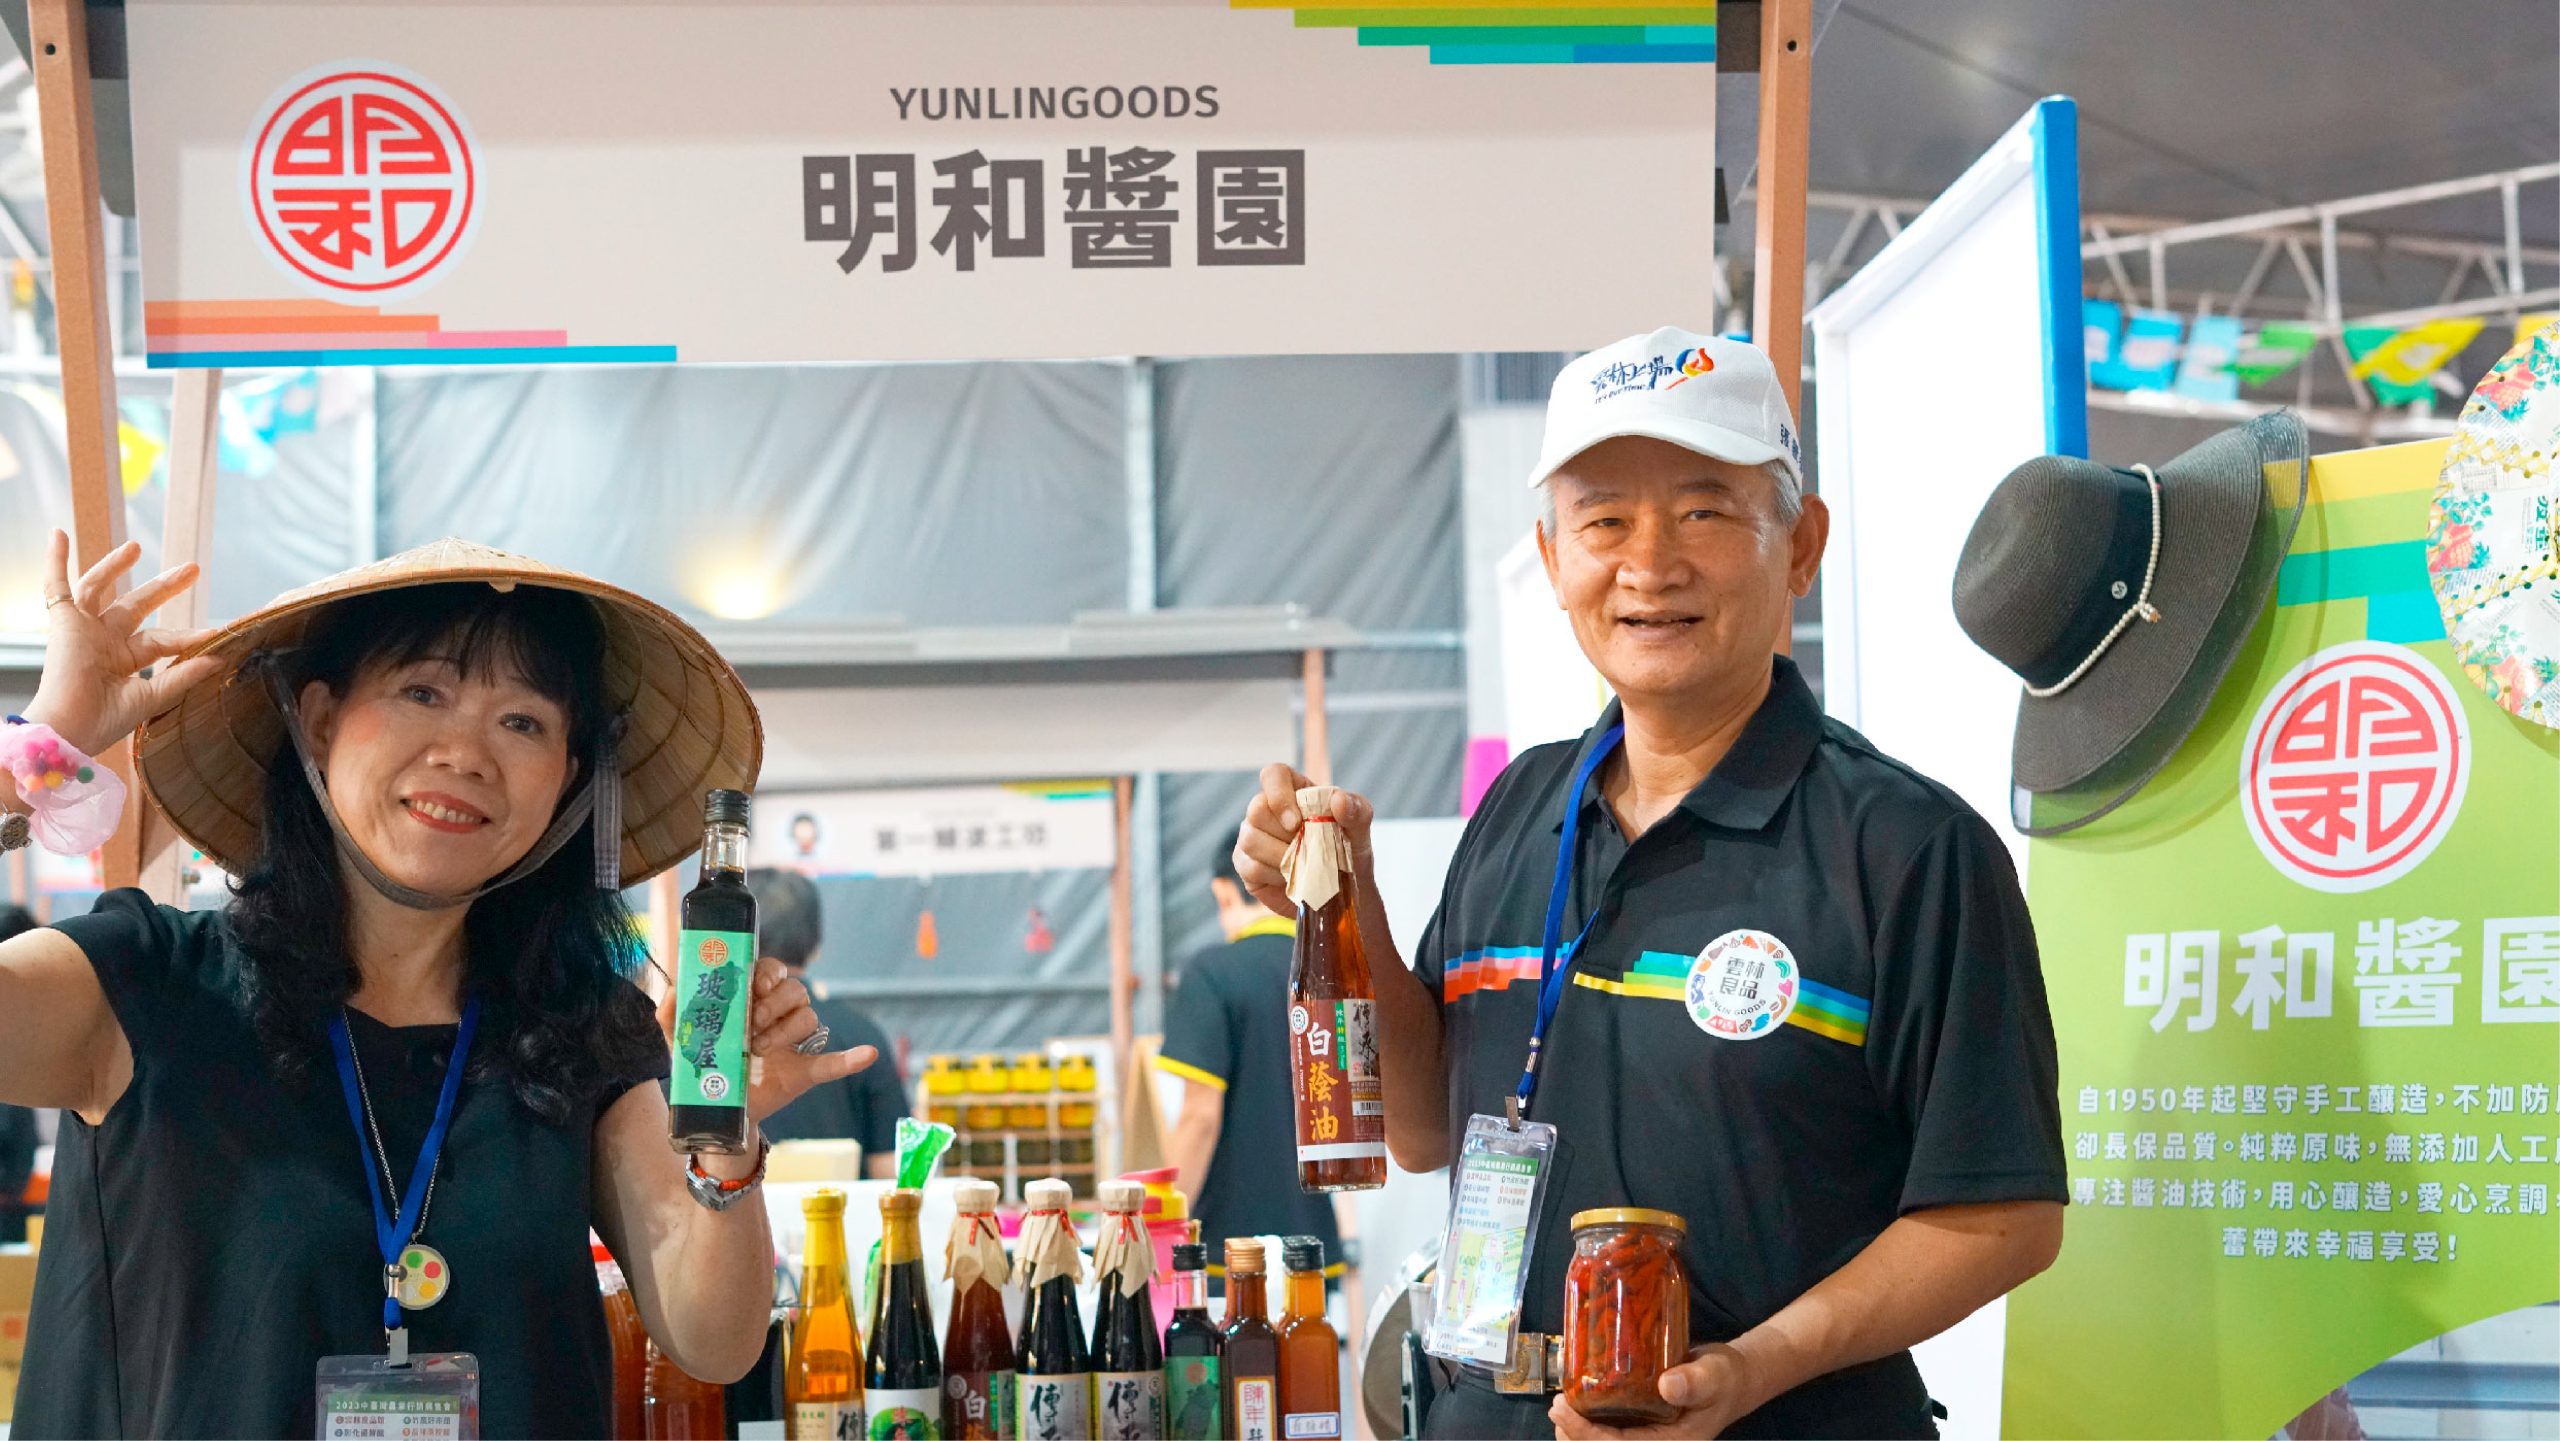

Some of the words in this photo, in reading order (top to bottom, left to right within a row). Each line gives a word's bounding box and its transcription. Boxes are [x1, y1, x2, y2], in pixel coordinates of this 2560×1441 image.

[890, 85, 1220, 120] YUNLINGOODS
[802, 146, 1306, 274] 明和醬園
[2123, 916, 2560, 1034] 明和醬園
[693, 969, 729, 1069] 玻璃屋
[1306, 1022, 1339, 1141] 白蔭油
[2078, 1083, 2560, 1115] 自1950年起堅守手工釀造，不加防
[2074, 1131, 2560, 1164] 卻長保品質。純粹原味，無添加人工
[2073, 1177, 2560, 1215] 專注醬油技術，用心釀造，愛心烹調
